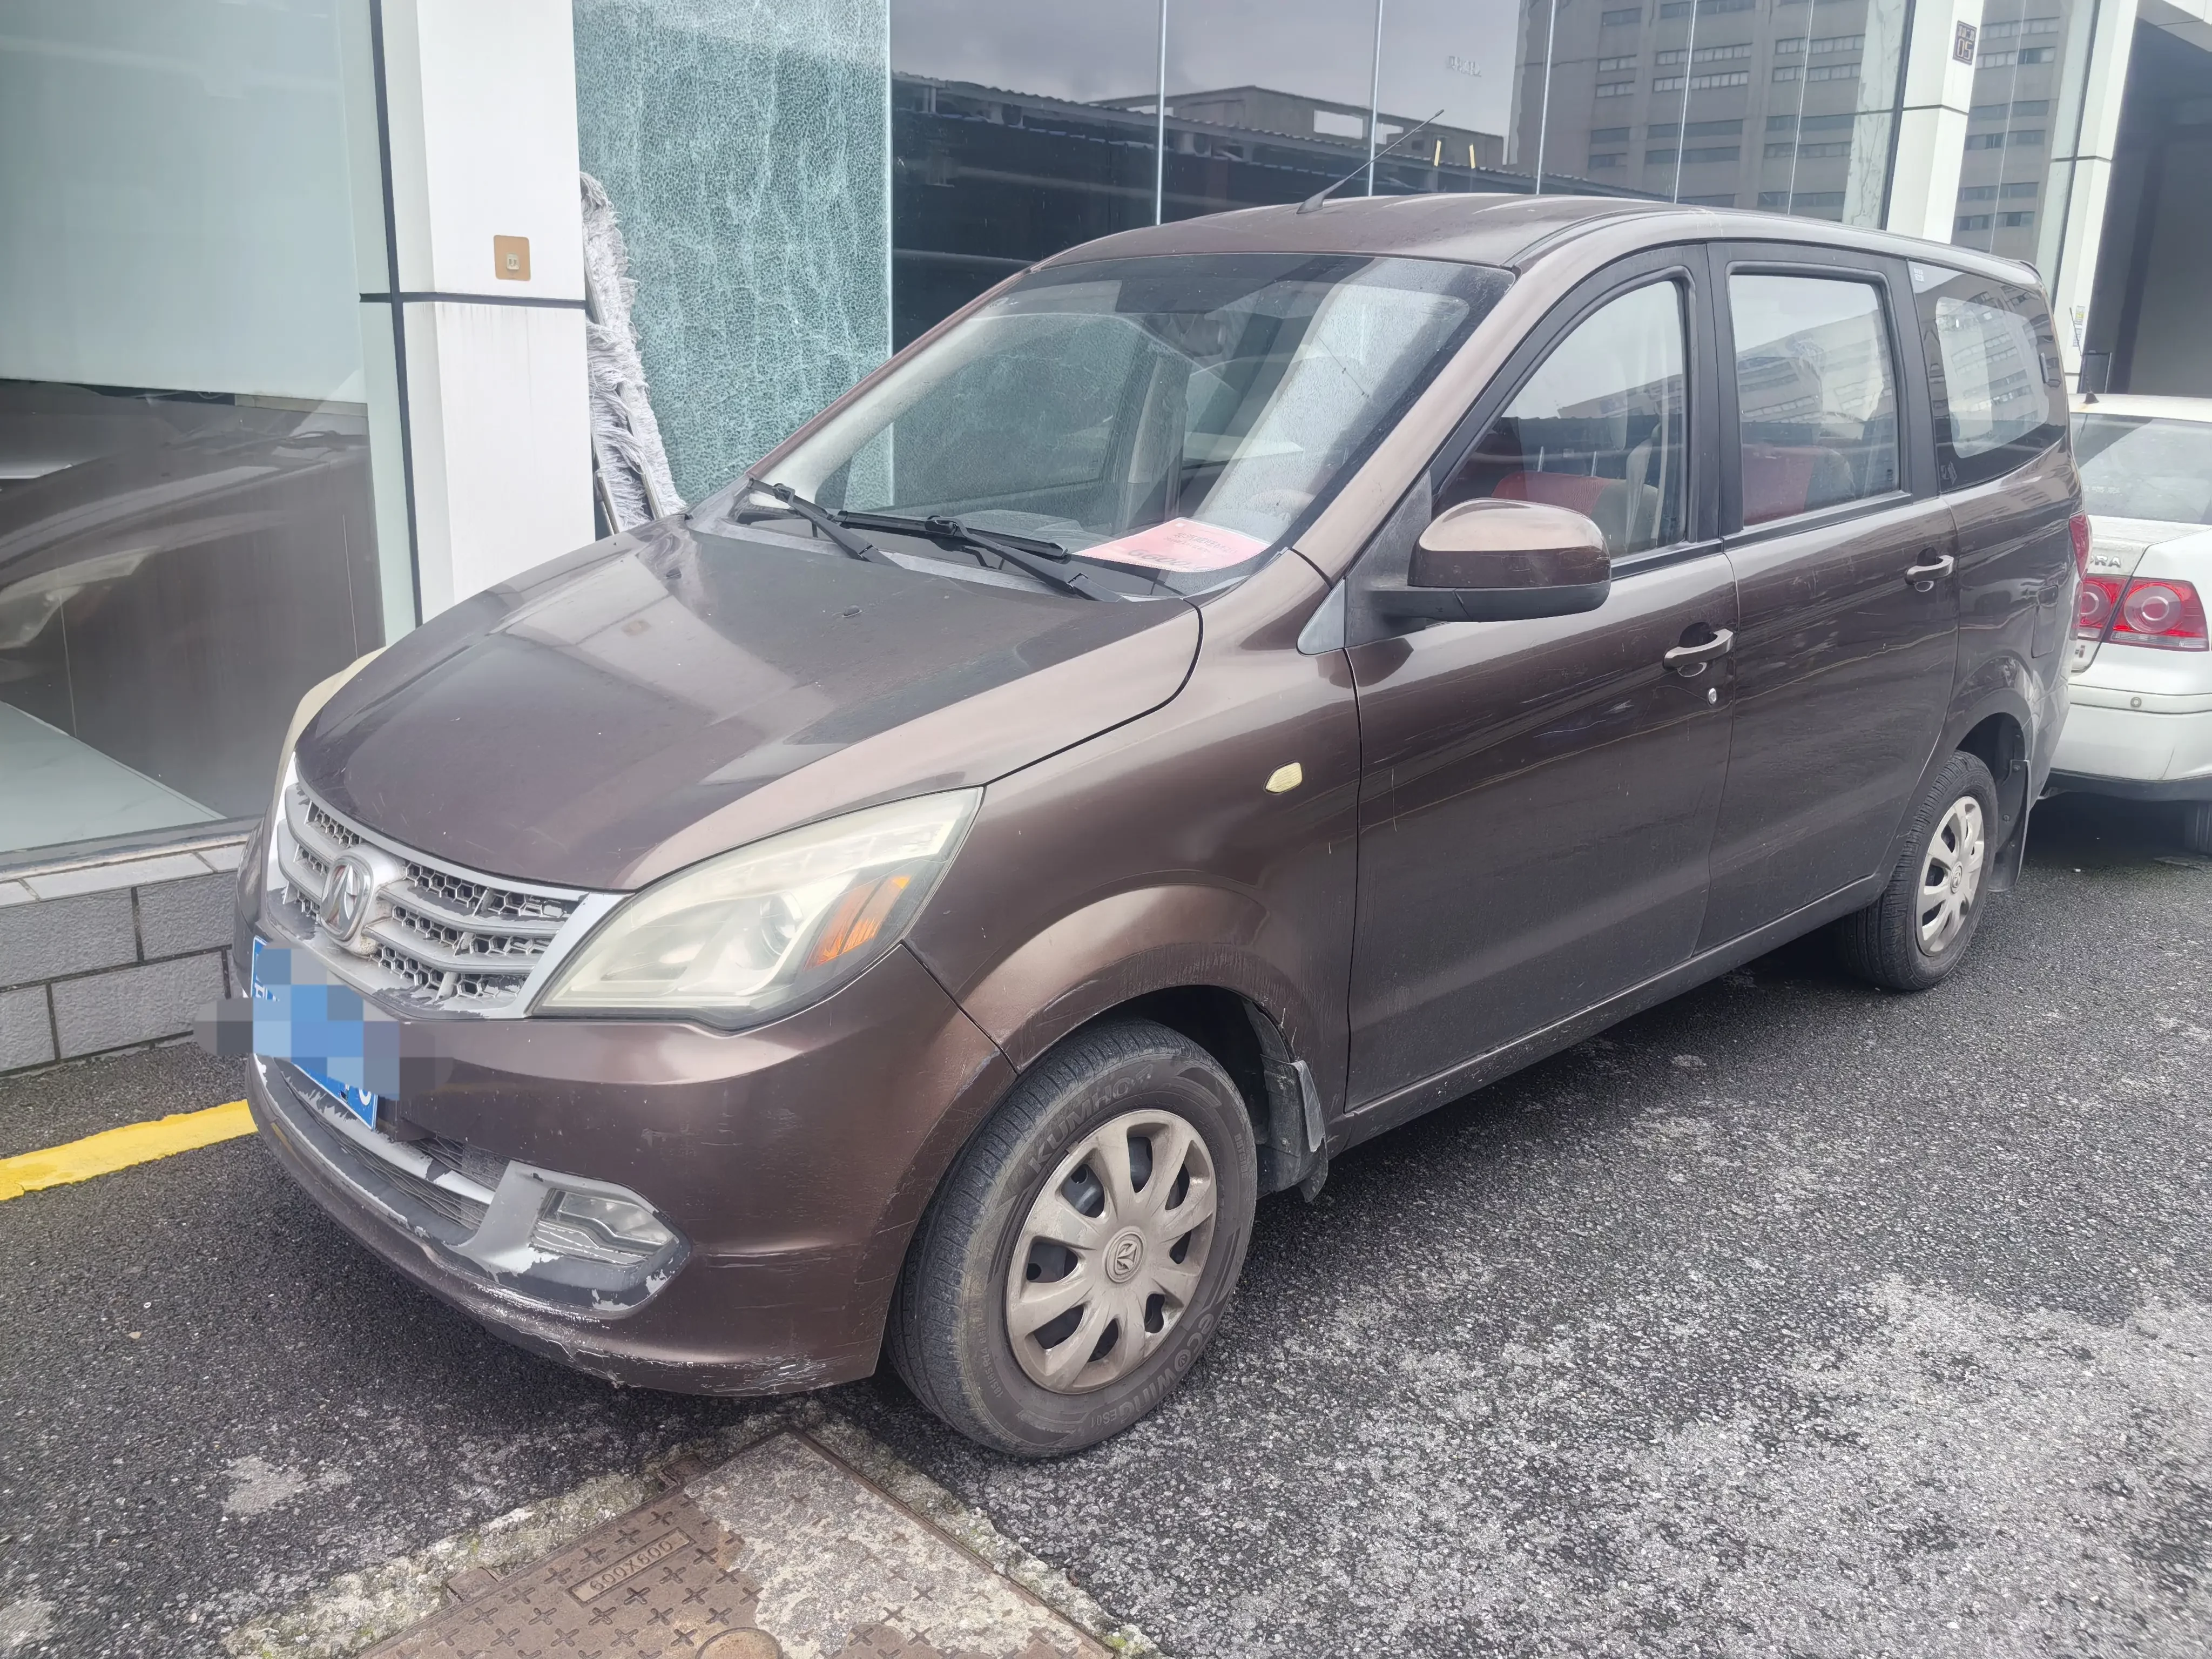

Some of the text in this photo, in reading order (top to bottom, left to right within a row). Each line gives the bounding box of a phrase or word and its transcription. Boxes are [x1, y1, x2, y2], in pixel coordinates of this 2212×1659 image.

[1028, 1077, 1131, 1174] KUMHO
[1234, 1133, 1248, 1178] OUTSIDE
[1091, 1408, 1117, 1427] ES01
